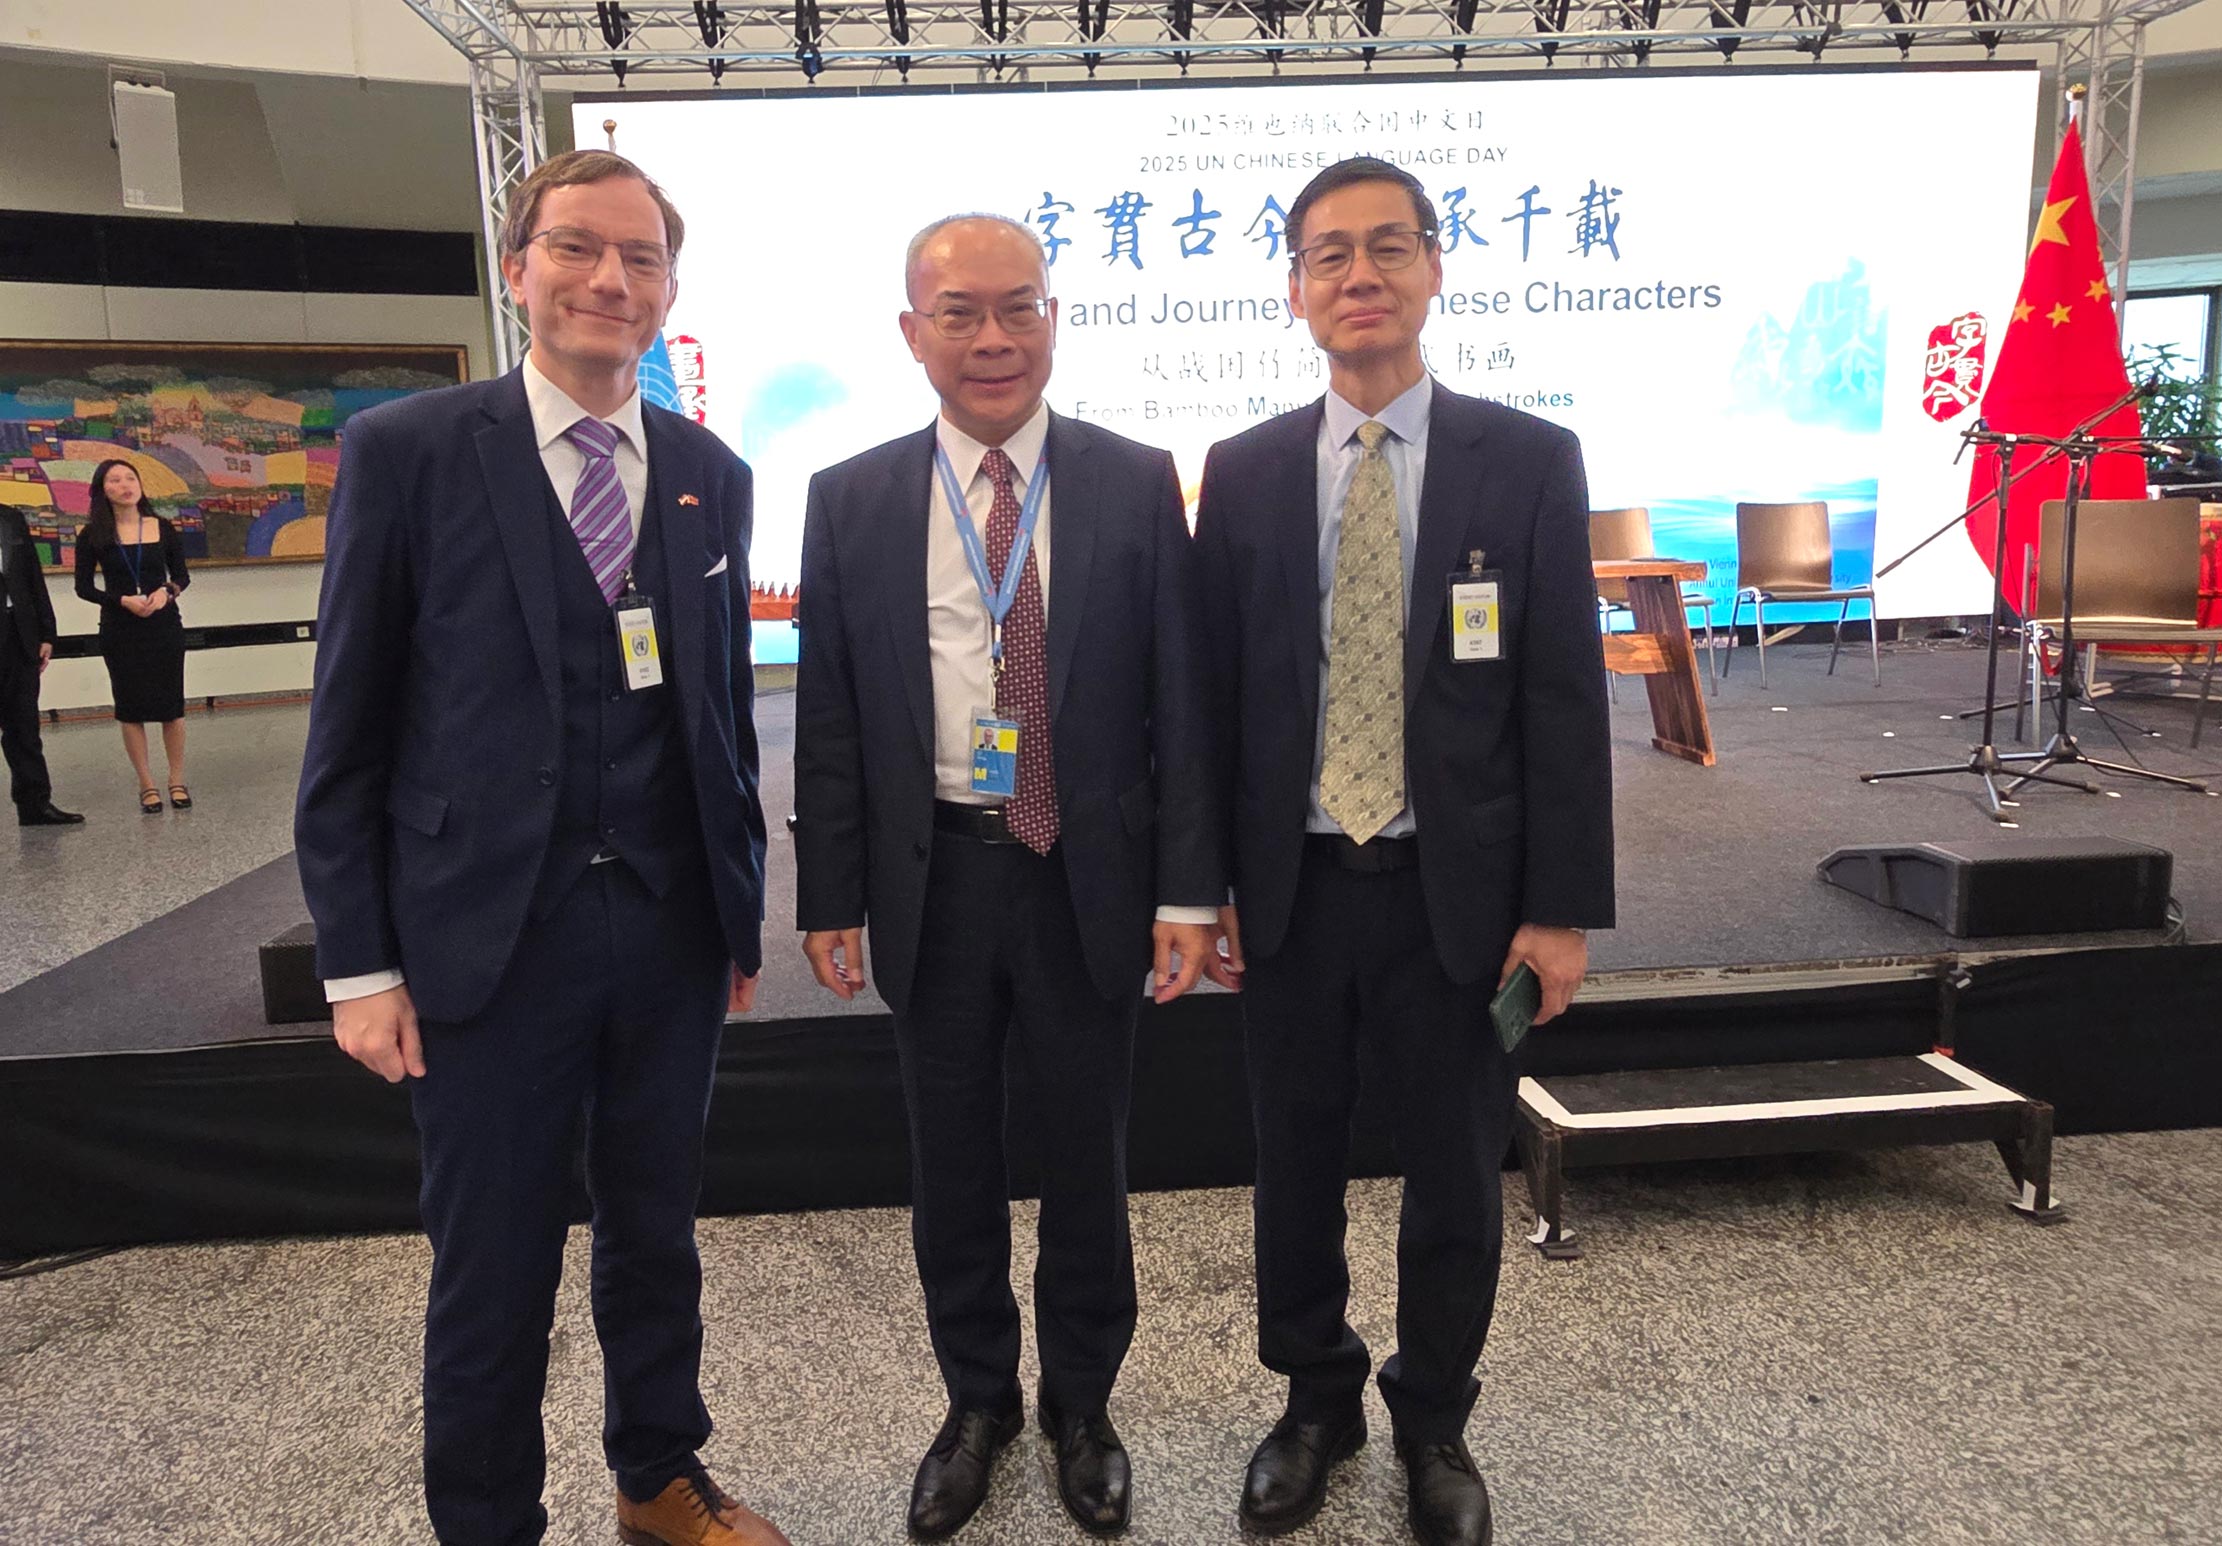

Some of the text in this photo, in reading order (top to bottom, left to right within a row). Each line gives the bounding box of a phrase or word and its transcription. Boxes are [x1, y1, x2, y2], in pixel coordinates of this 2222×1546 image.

[1140, 156, 1188, 172] 2025
[1196, 154, 1225, 171] UN
[1233, 152, 1328, 169] CHINESE
[1467, 147, 1508, 164] DAY
[1070, 294, 1136, 326] and
[1525, 279, 1722, 314] Characters
[1144, 400, 1238, 419] Bamboo
